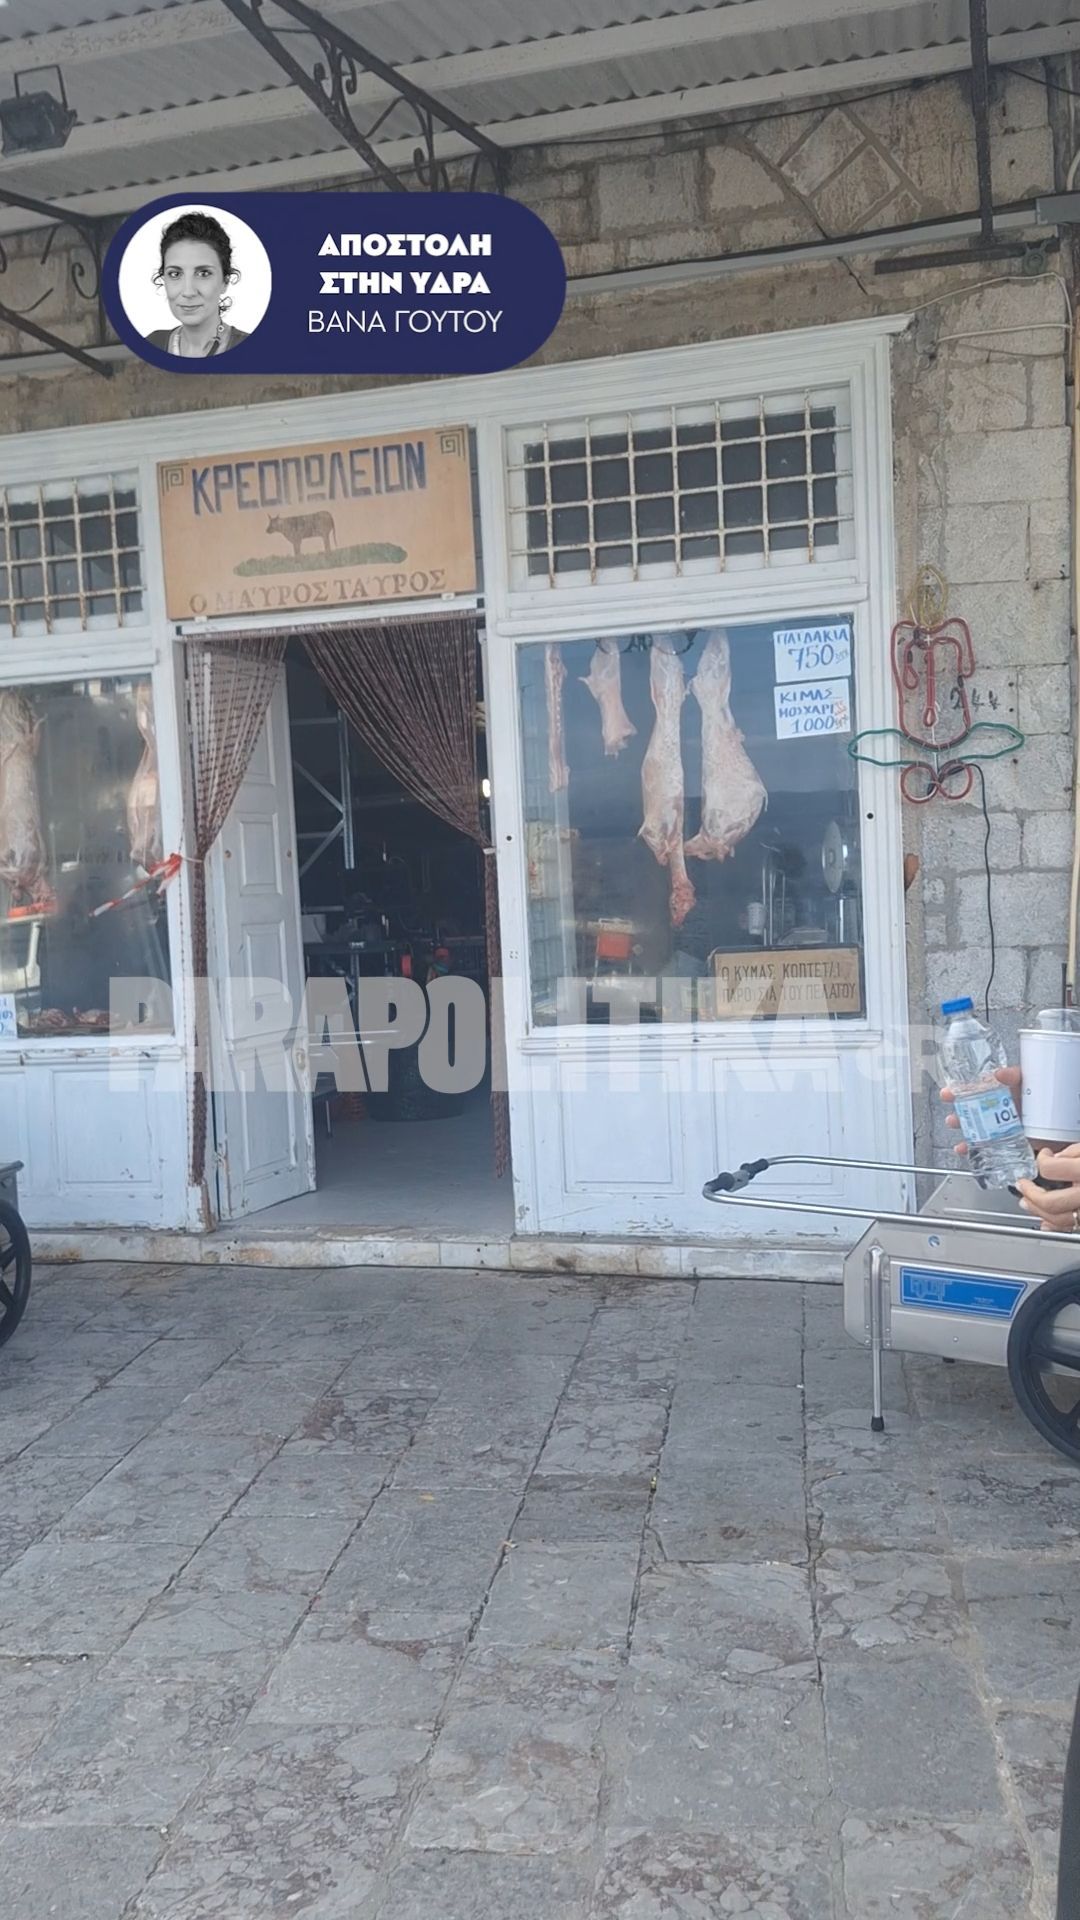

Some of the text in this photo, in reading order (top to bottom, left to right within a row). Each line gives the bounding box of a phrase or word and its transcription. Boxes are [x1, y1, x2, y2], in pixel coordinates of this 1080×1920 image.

[191, 441, 427, 516] ΚΡΕΟΠΩΛΕΙΟΝ
[189, 593, 208, 614] Ο
[788, 644, 834, 670] 750
[791, 715, 835, 734] 1000
